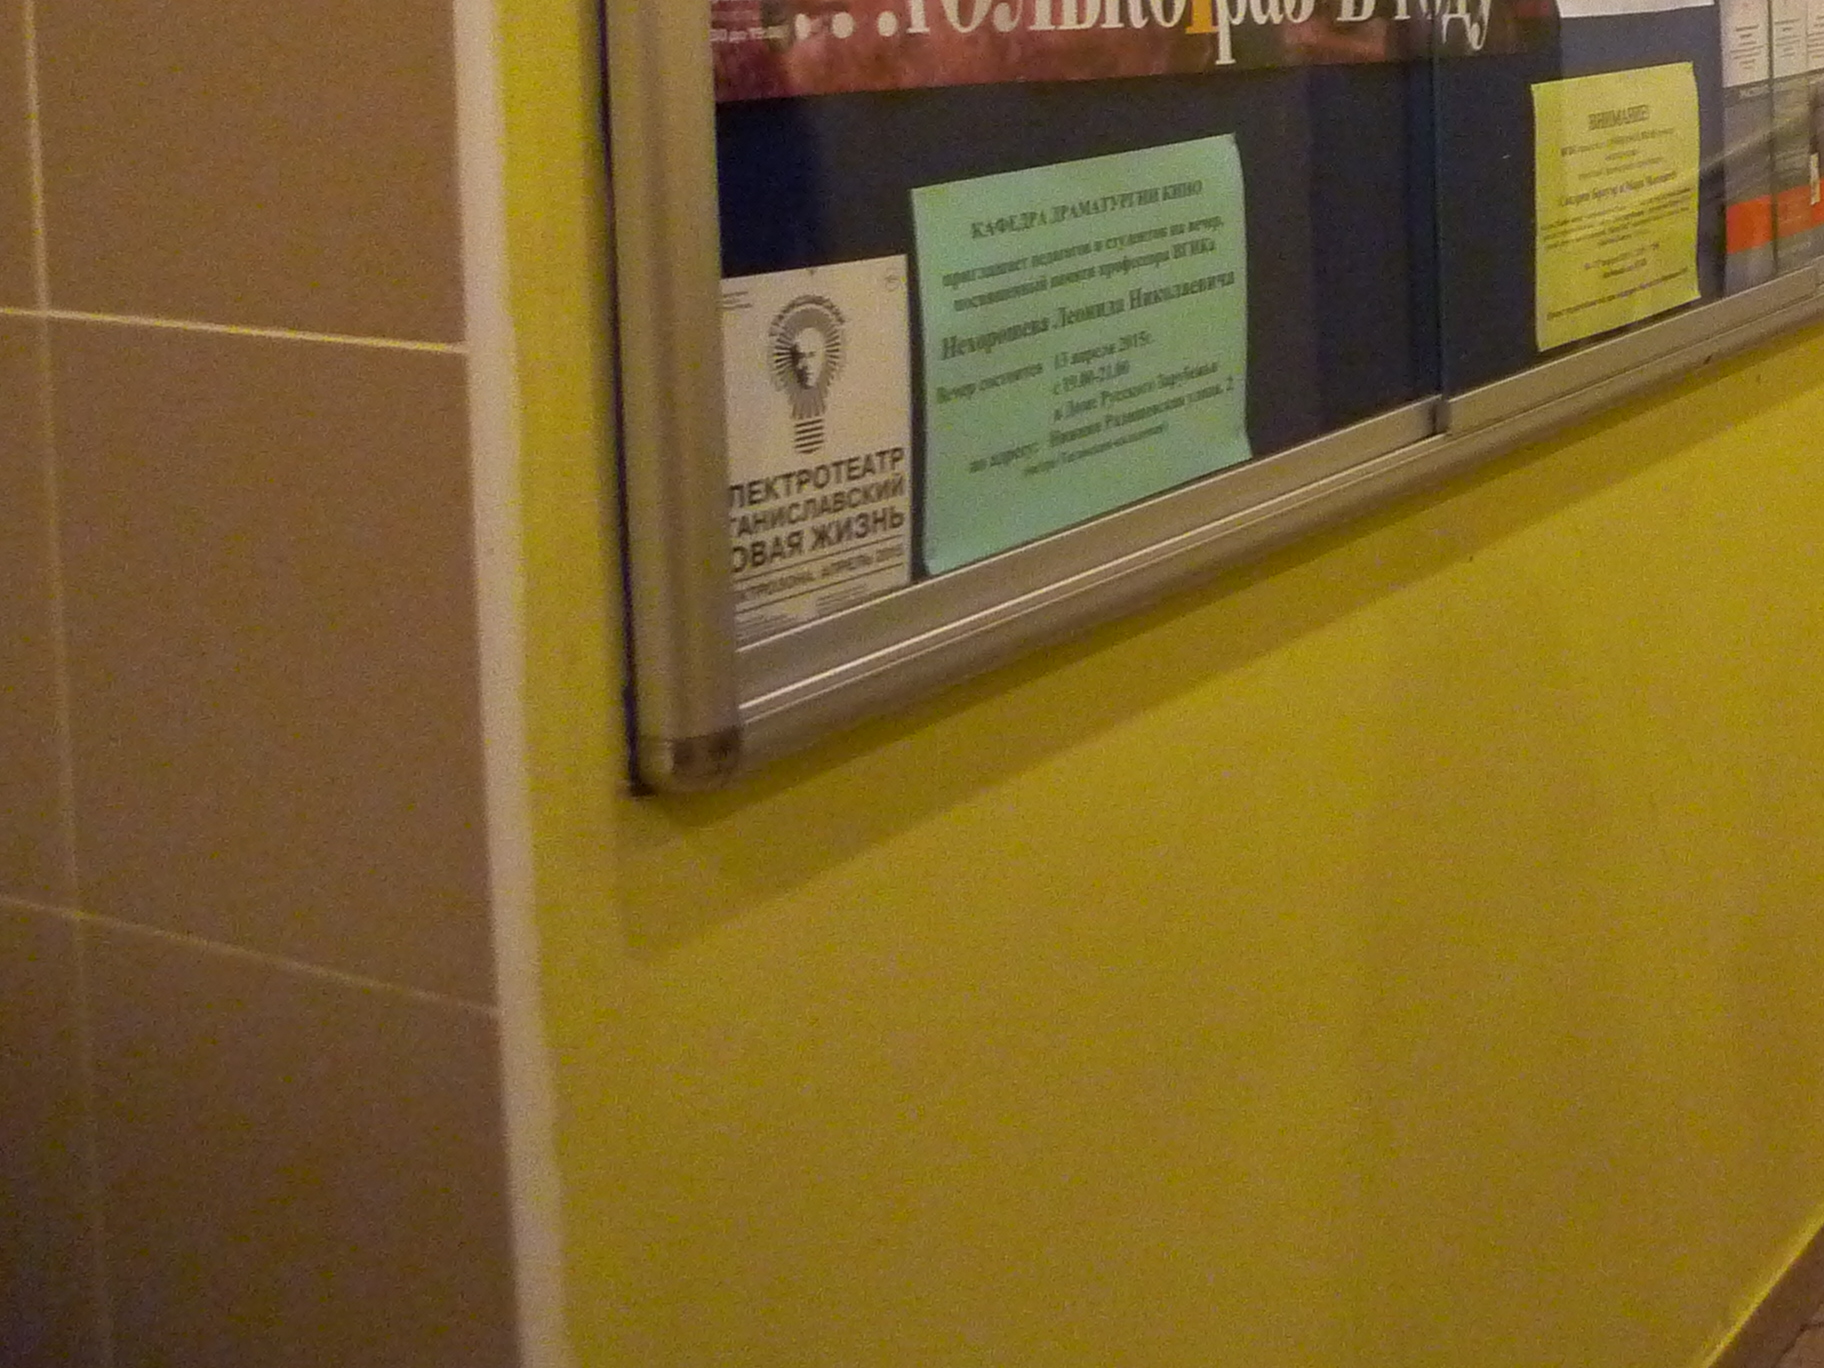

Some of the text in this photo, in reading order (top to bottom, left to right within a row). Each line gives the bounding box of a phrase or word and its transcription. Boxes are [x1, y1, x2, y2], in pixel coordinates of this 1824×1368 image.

[972, 180, 1204, 239] КАФЕДРА ДРАМАТУРГИИ КИНО
[1051, 299, 1126, 330] Леонида
[1129, 271, 1235, 310] Николаевича
[729, 447, 905, 508] ЛЕКТРОТЕАТР
[729, 472, 904, 538] АНИСЛАВСКИЙ
[731, 505, 905, 573] ОВАЯ ЖИЗНЬ
